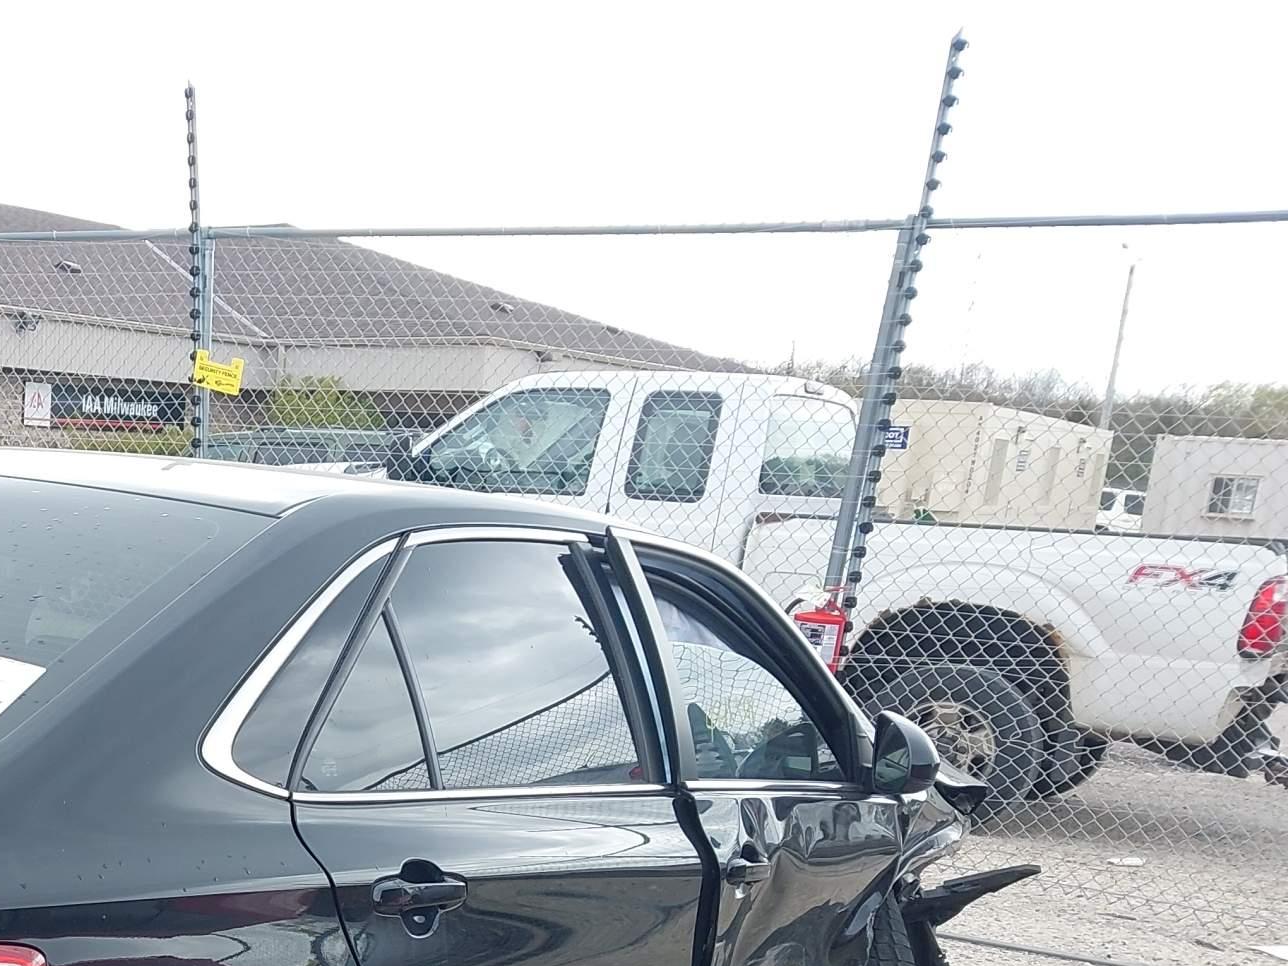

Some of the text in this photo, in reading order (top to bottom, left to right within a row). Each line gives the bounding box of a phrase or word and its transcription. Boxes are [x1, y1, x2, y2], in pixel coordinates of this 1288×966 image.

[82, 395, 159, 417] IAA Milwaukee
[1127, 565, 1238, 592] FX4
